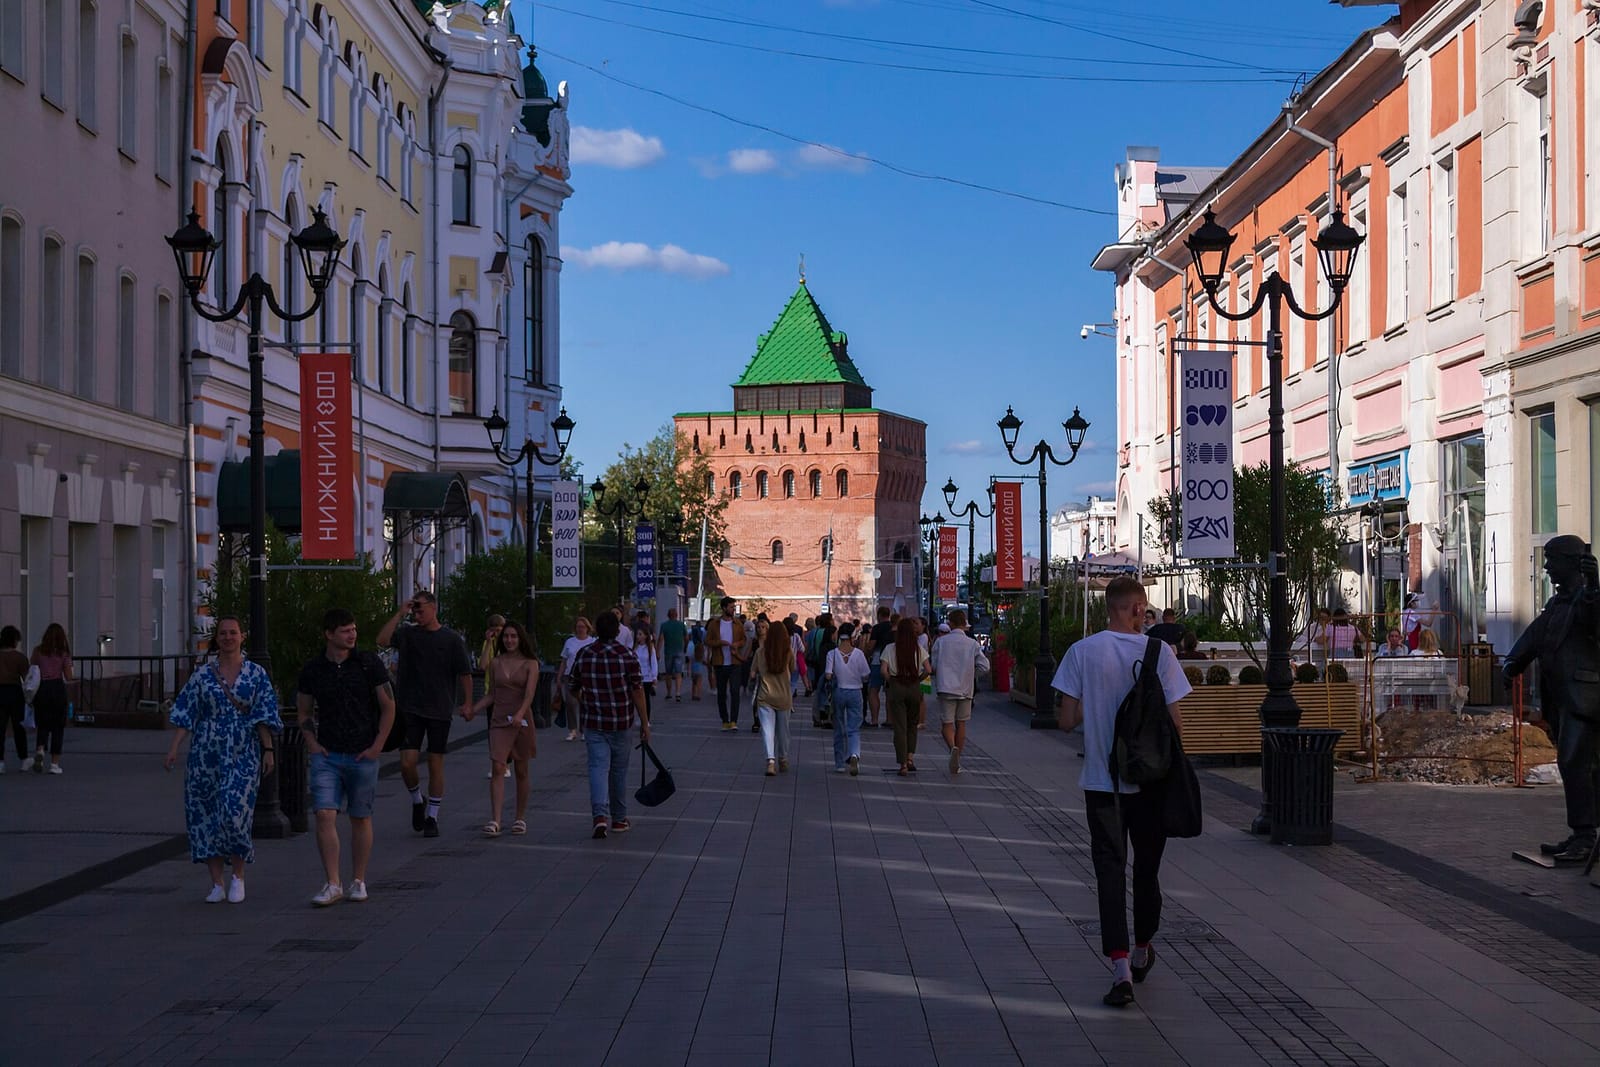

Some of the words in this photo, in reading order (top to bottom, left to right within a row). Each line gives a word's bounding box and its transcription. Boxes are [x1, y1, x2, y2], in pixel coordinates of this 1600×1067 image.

[1185, 369, 1227, 390] 800
[313, 421, 338, 540] НИЖНИЙ
[1186, 479, 1228, 501] 800
[1002, 516, 1015, 579] НИЖНИЙ
[555, 566, 577, 577] 800
[638, 569, 653, 578] 800
[940, 583, 955, 592] 800
